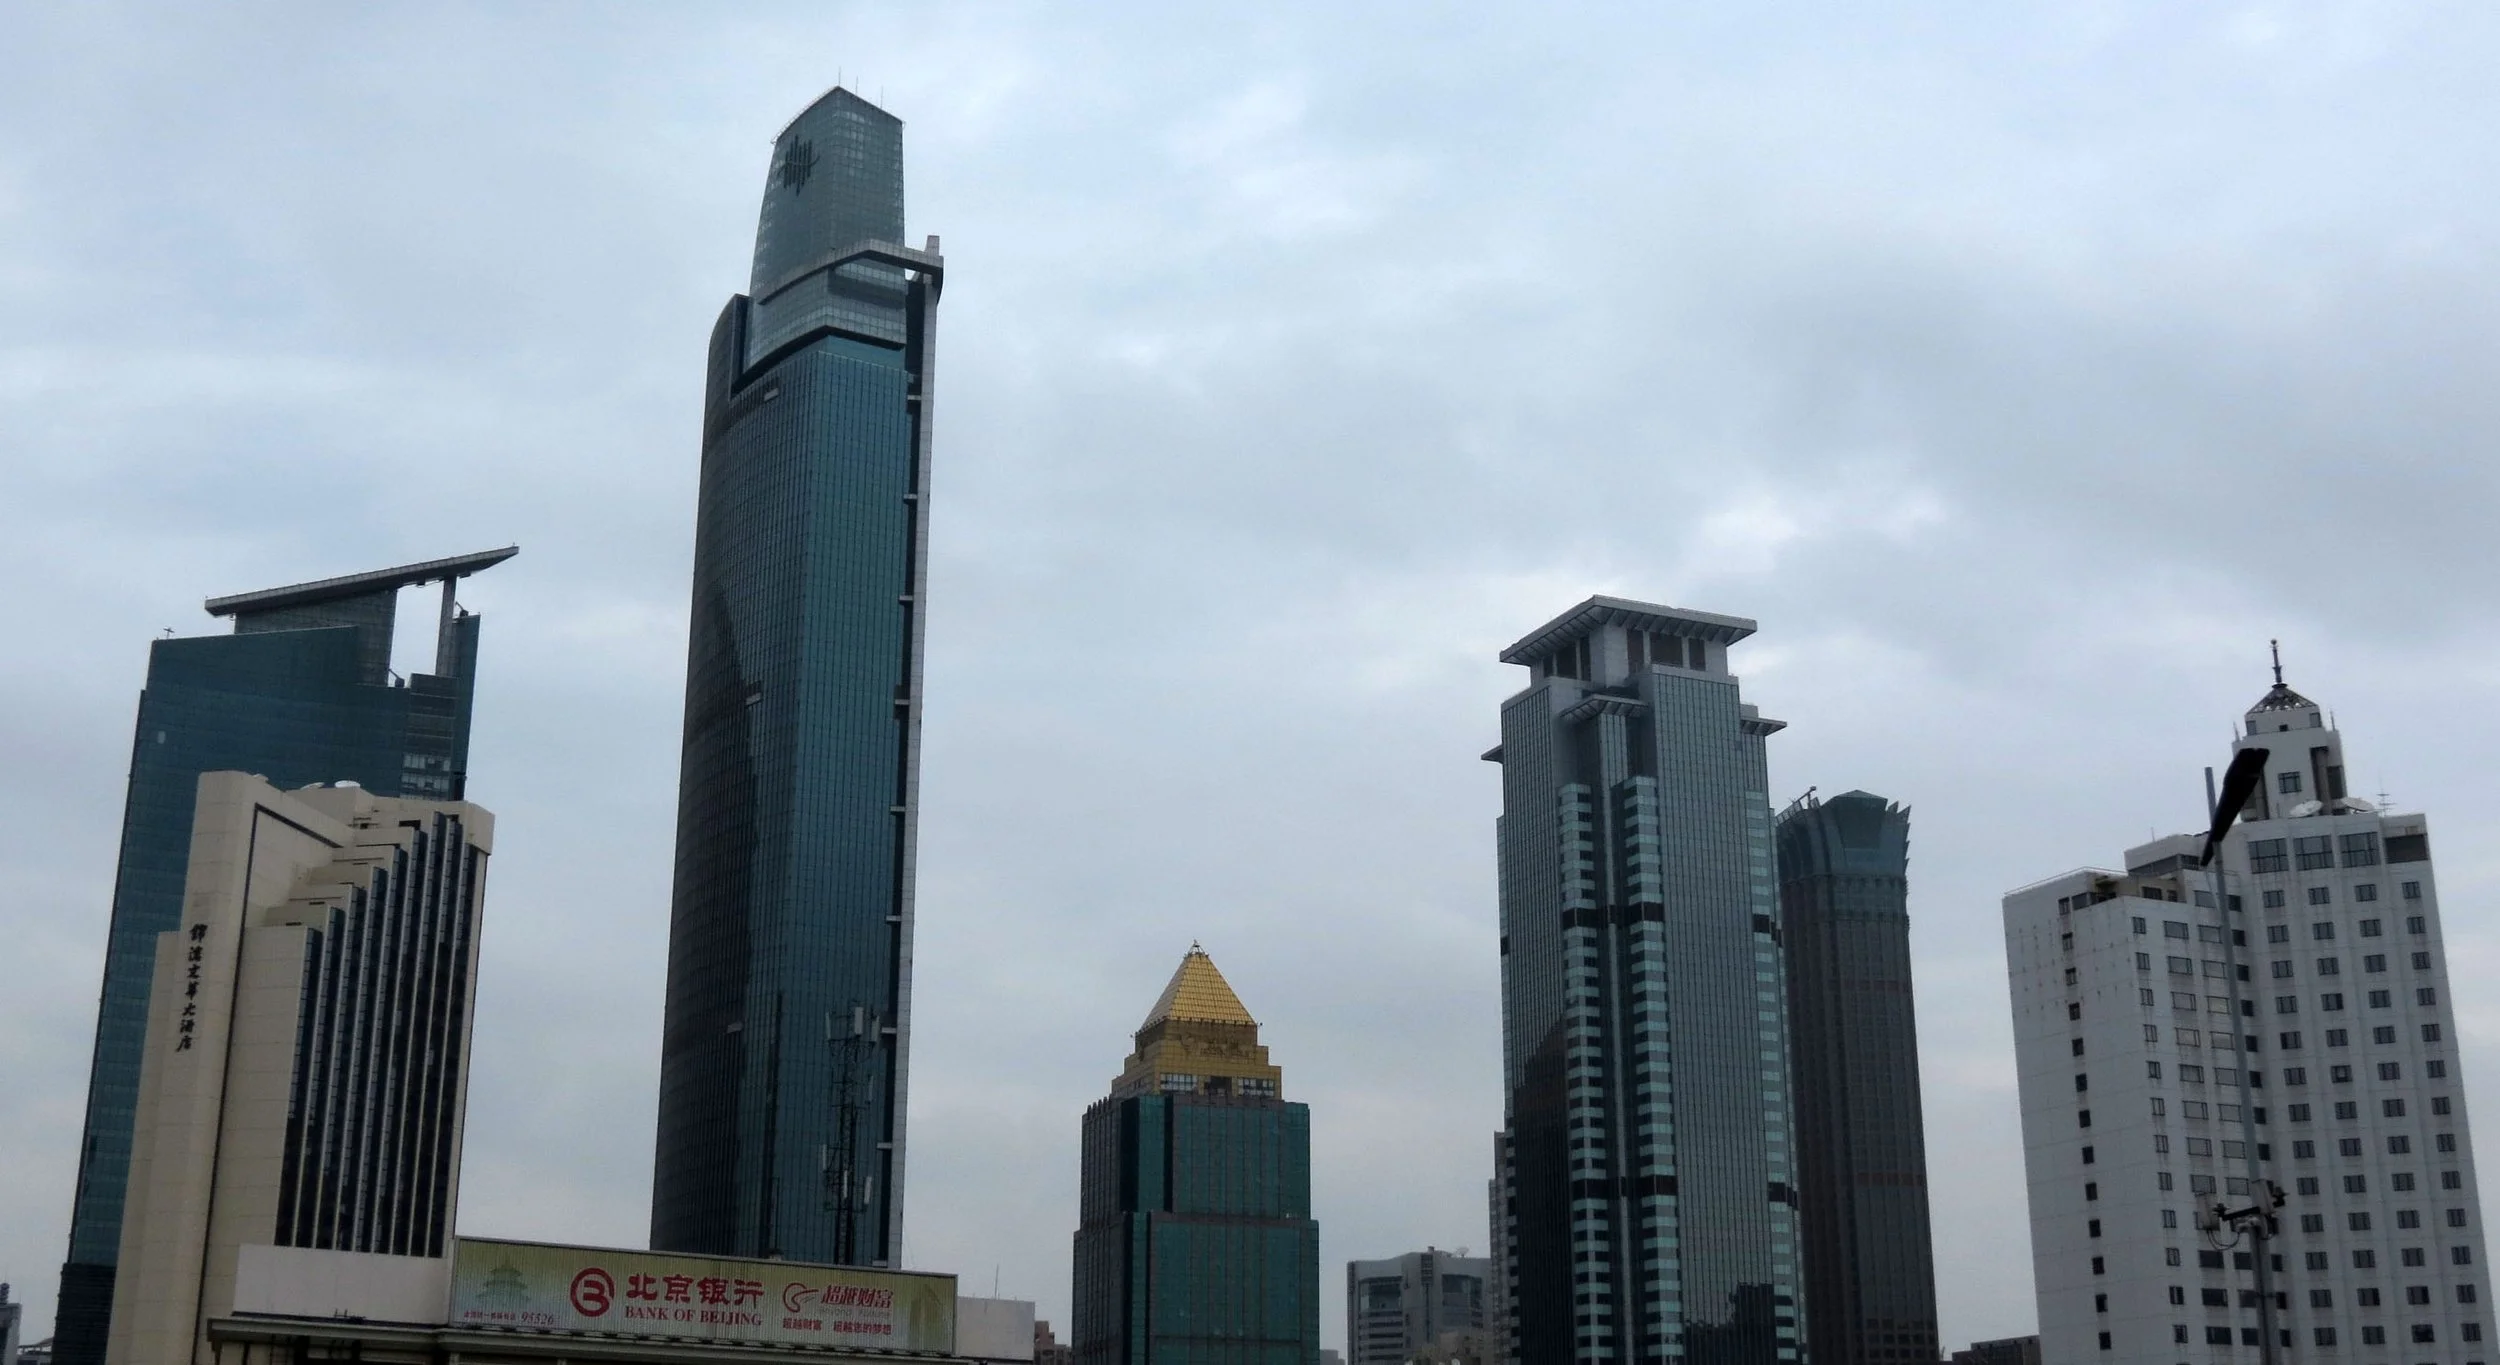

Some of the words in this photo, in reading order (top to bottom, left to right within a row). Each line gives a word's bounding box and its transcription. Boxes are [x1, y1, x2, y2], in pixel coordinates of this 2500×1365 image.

[626, 1273, 764, 1306] 北京银行
[521, 1311, 555, 1325] 95526
[626, 1306, 671, 1321] BANK
[674, 1309, 696, 1323] OF
[700, 1312, 763, 1328] BEIJING
